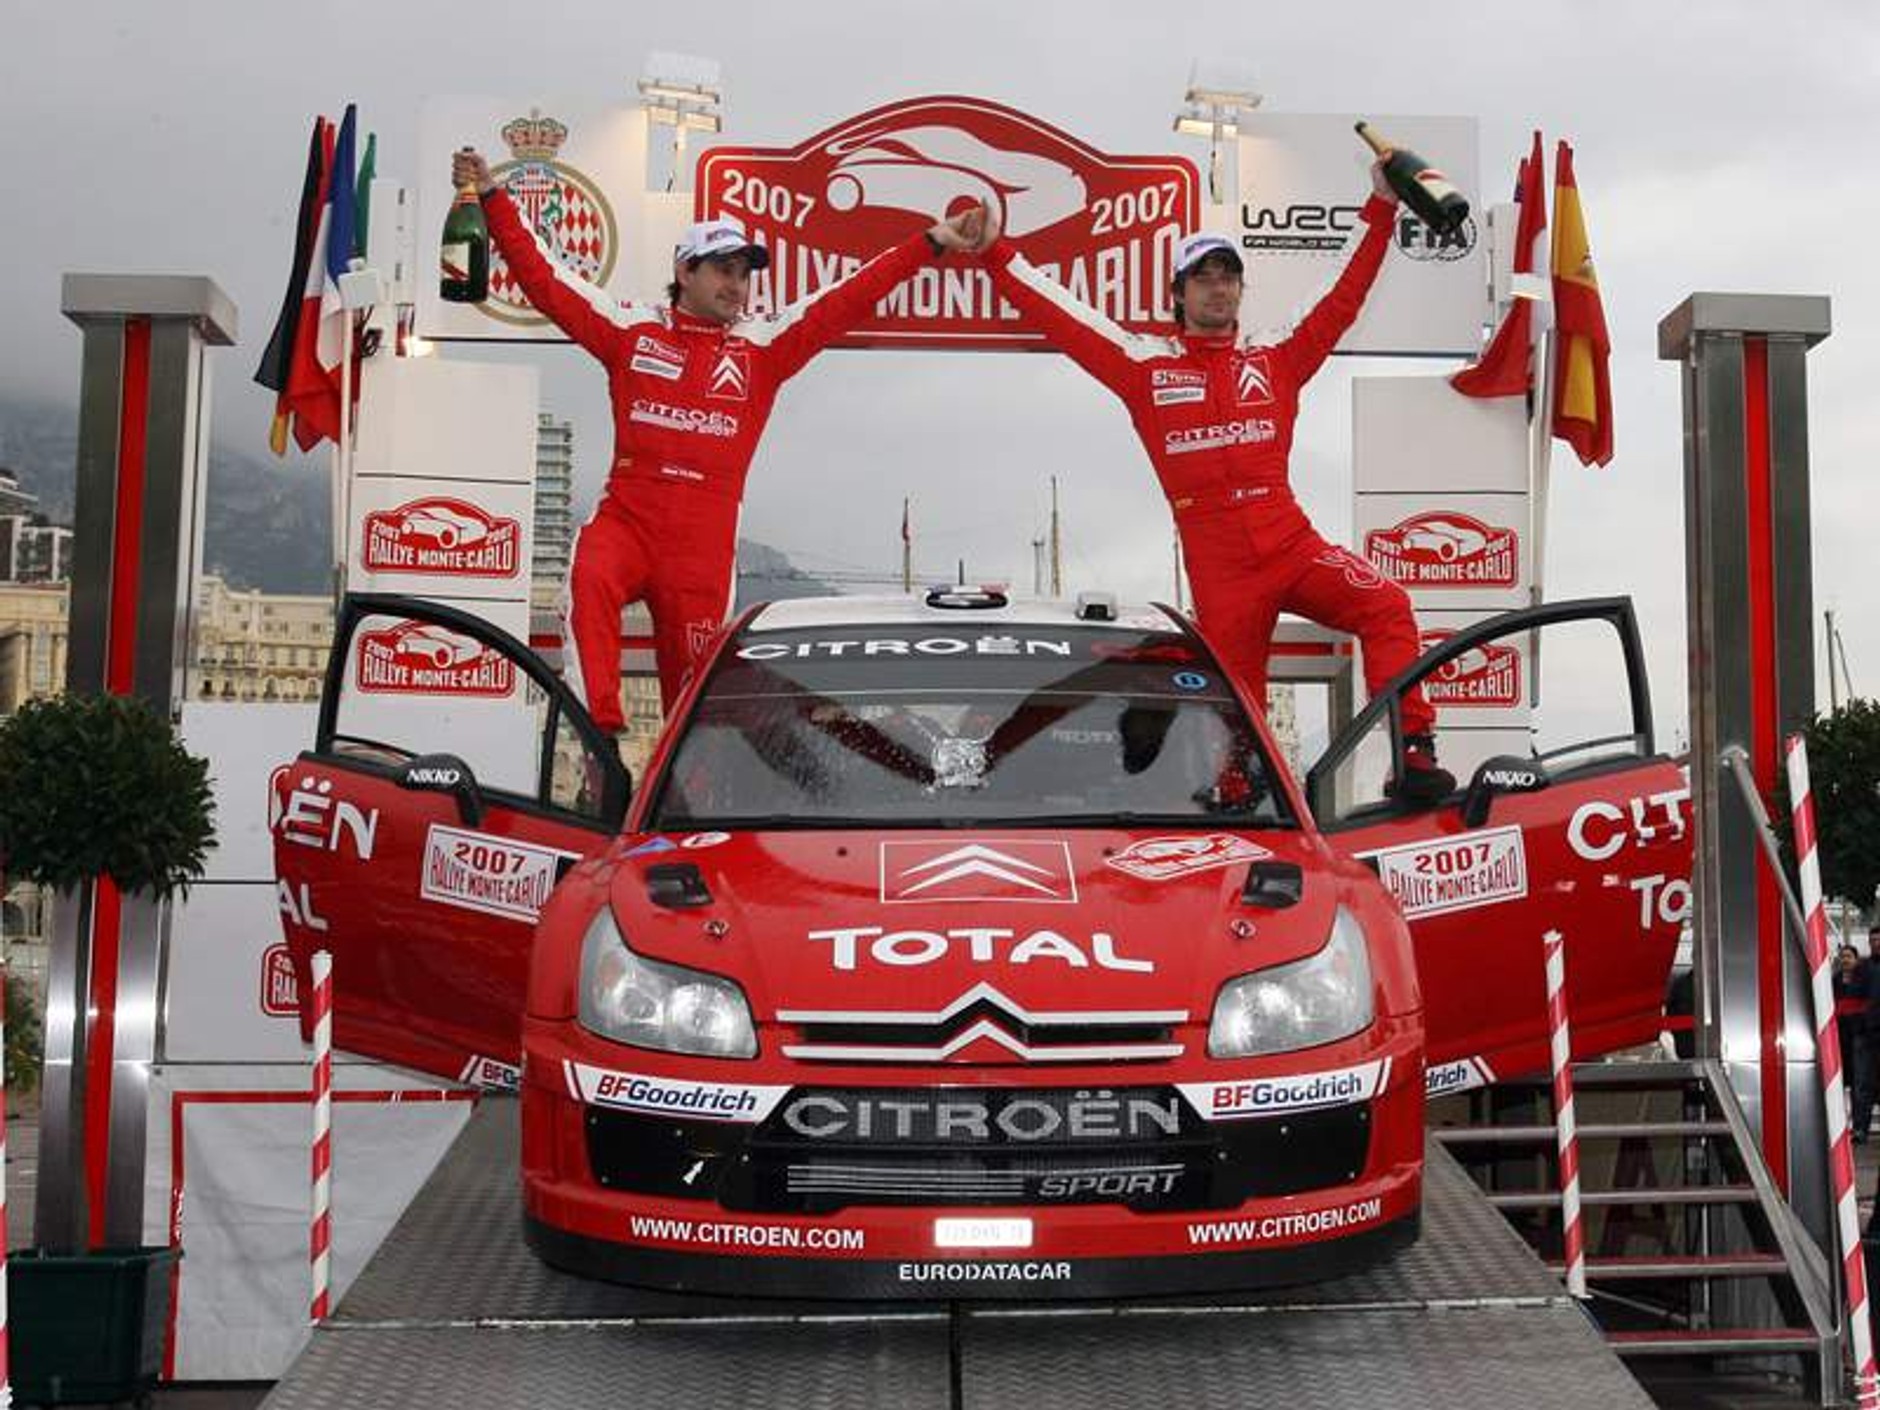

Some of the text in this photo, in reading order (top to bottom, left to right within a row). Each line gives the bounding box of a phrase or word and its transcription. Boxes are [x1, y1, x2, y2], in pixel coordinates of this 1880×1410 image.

[722, 168, 816, 228] 2007
[1090, 181, 1179, 236] 2007
[1243, 203, 1362, 230] WRC
[1400, 217, 1469, 248] FIA
[369, 534, 513, 570] RALLYE MONTE-CARLO
[1419, 551, 1512, 580] MONTE-CARLO
[736, 634, 1071, 660] CITROËN
[363, 653, 508, 688] RALLYE MONTE-CARLO
[405, 768, 461, 785] NIKKO
[1482, 769, 1536, 787] NIKKO
[431, 845, 466, 892] RALLYE
[454, 841, 527, 875] 2007
[1415, 843, 1491, 875] 2007
[1389, 869, 1433, 908] RALLYE
[808, 927, 1155, 972] TOTAL
[597, 1074, 757, 1113] BFGoodrich
[1213, 1073, 1363, 1108] BFGoodrich
[782, 1090, 1180, 1139] CITROËN
[1038, 1171, 1185, 1196] SPORT
[630, 1215, 865, 1250] WWW.CITROEN.COM
[1188, 1199, 1382, 1244] WWW.CITROEN.COM
[899, 1261, 1072, 1283] EURODATACAR
